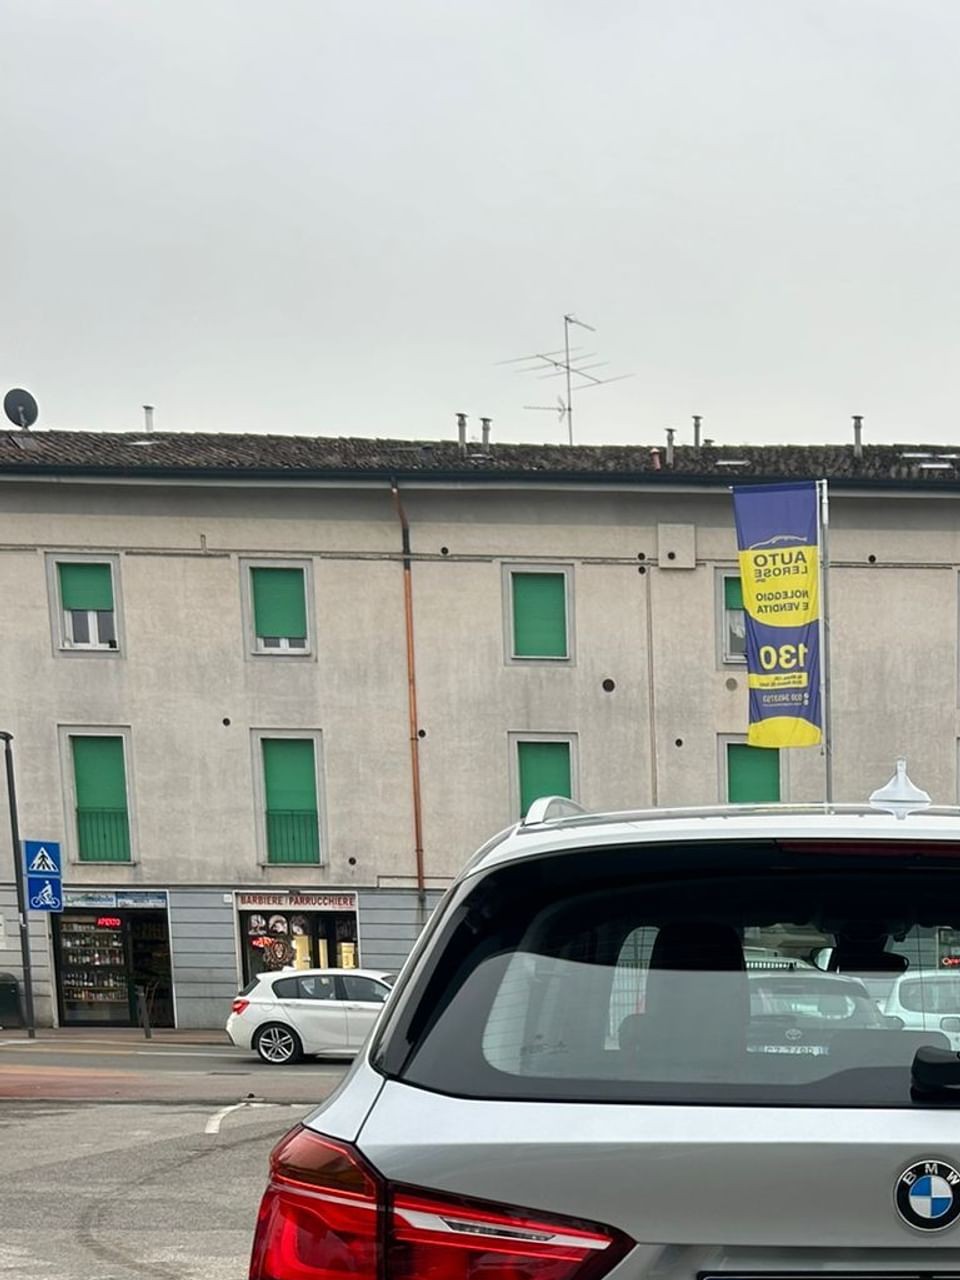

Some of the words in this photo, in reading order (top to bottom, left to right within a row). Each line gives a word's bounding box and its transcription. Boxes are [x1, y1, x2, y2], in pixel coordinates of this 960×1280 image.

[240, 895, 284, 906] BARBIERE
[288, 896, 354, 907] PARRUCCHIERE
[902, 1163, 960, 1186] BMW
